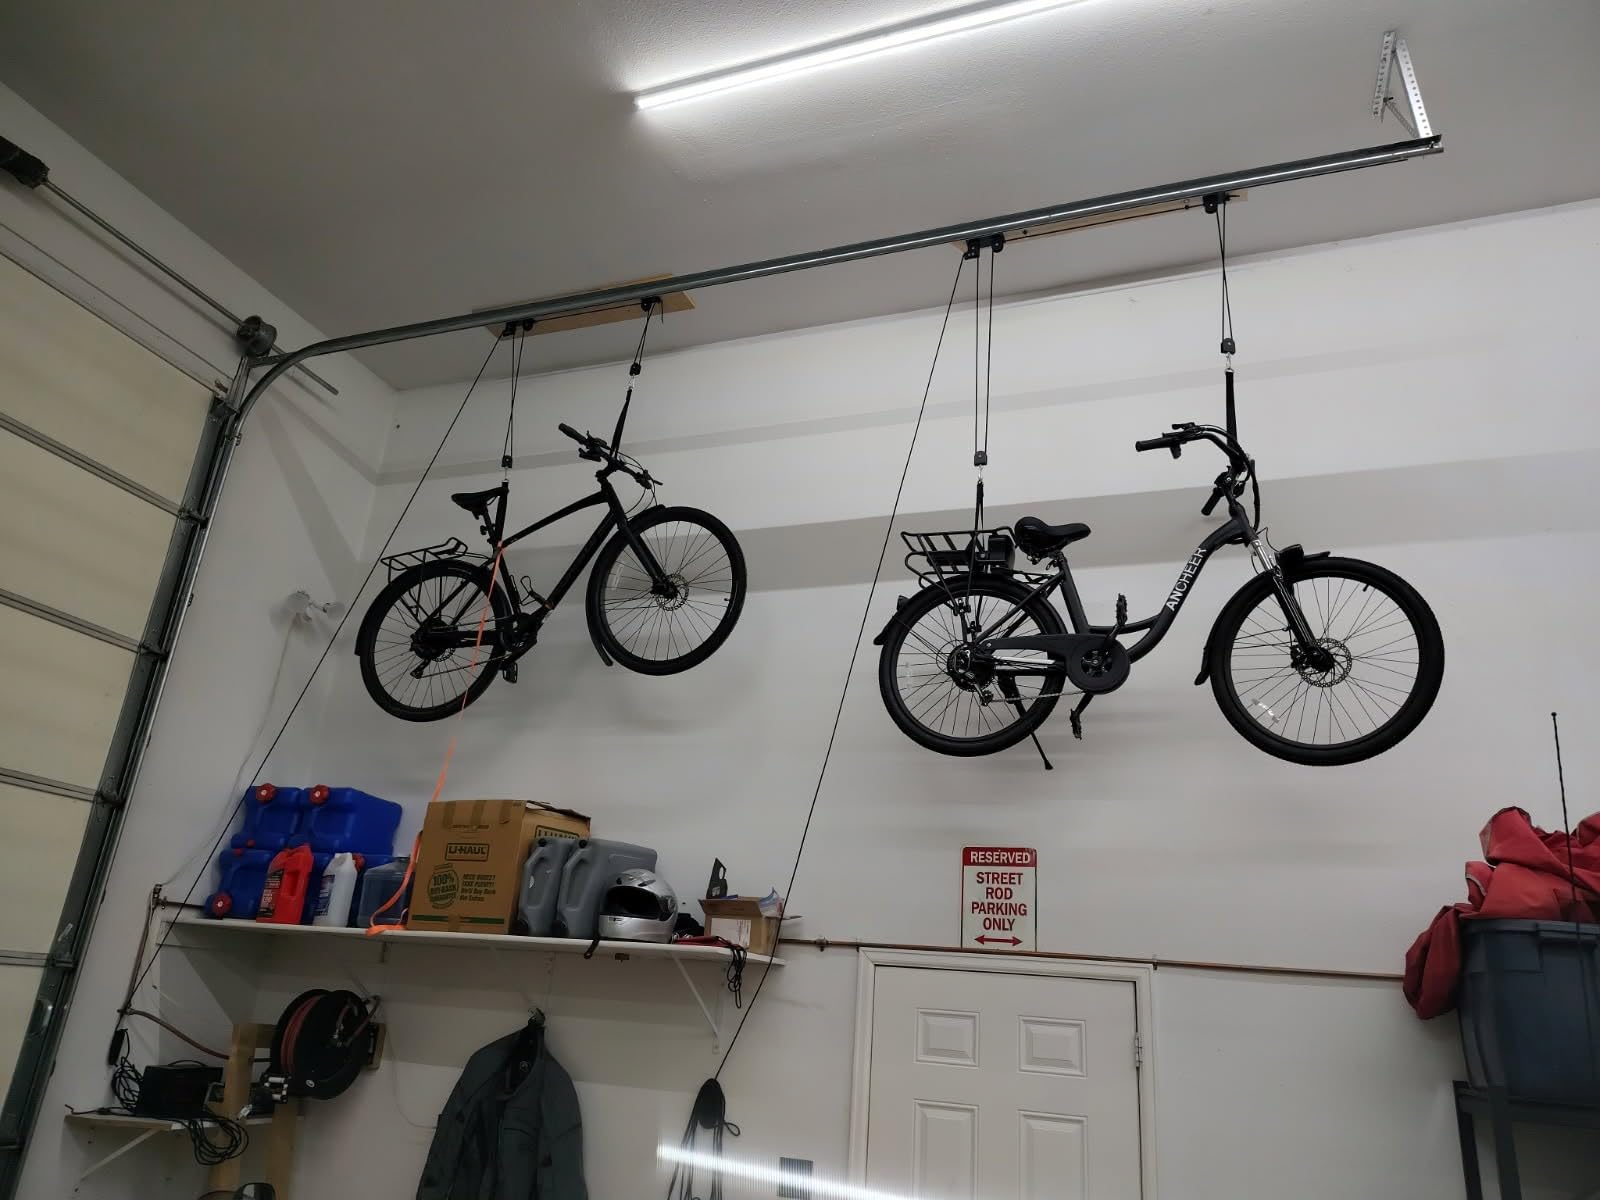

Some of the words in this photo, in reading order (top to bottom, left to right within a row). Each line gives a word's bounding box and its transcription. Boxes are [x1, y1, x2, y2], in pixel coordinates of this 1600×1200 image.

[1166, 547, 1207, 611] ANCHEER
[448, 845, 487, 855] U-HAUL
[970, 851, 1031, 864] RESERVED
[432, 872, 455, 886] 100%
[976, 872, 1024, 885] STREET
[985, 887, 1013, 900] ROD
[971, 902, 1028, 916] PARKING
[982, 917, 1016, 931] ONLY
